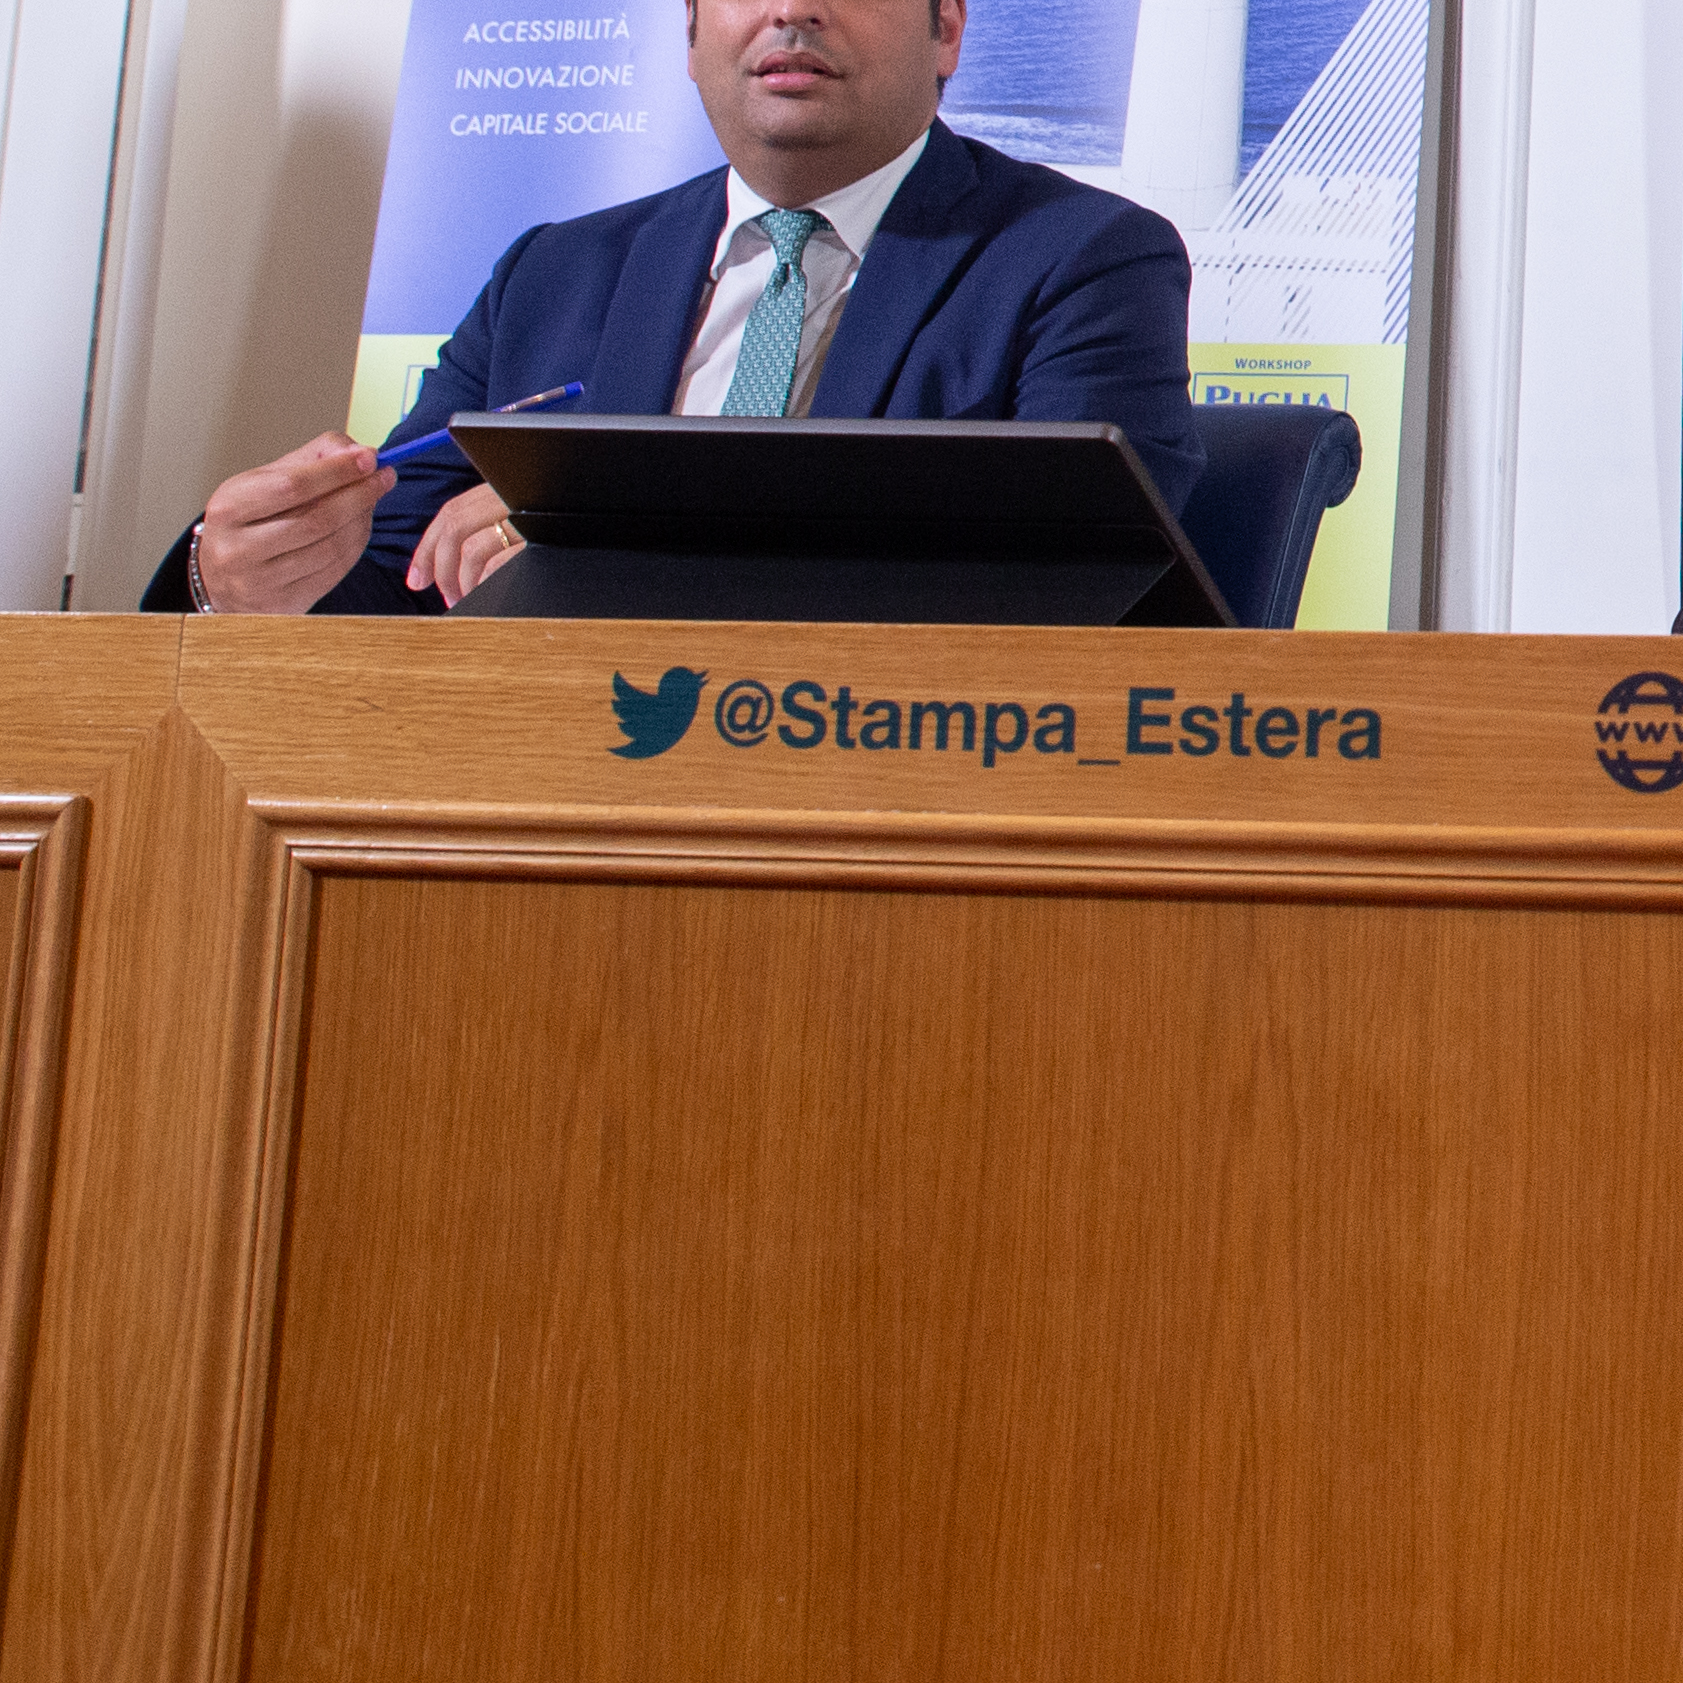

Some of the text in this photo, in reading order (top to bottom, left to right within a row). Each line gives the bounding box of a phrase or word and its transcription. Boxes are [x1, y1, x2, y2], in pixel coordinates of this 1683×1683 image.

[463, 13, 630, 44] ACCESSIBILITÀ
[455, 65, 634, 89] INNOVAZIONE
[451, 112, 648, 136] CAPITALE SOCIALE
[1235, 358, 1311, 370] WORKSHOP
[713, 679, 1383, 768] @Stampa_Estera
